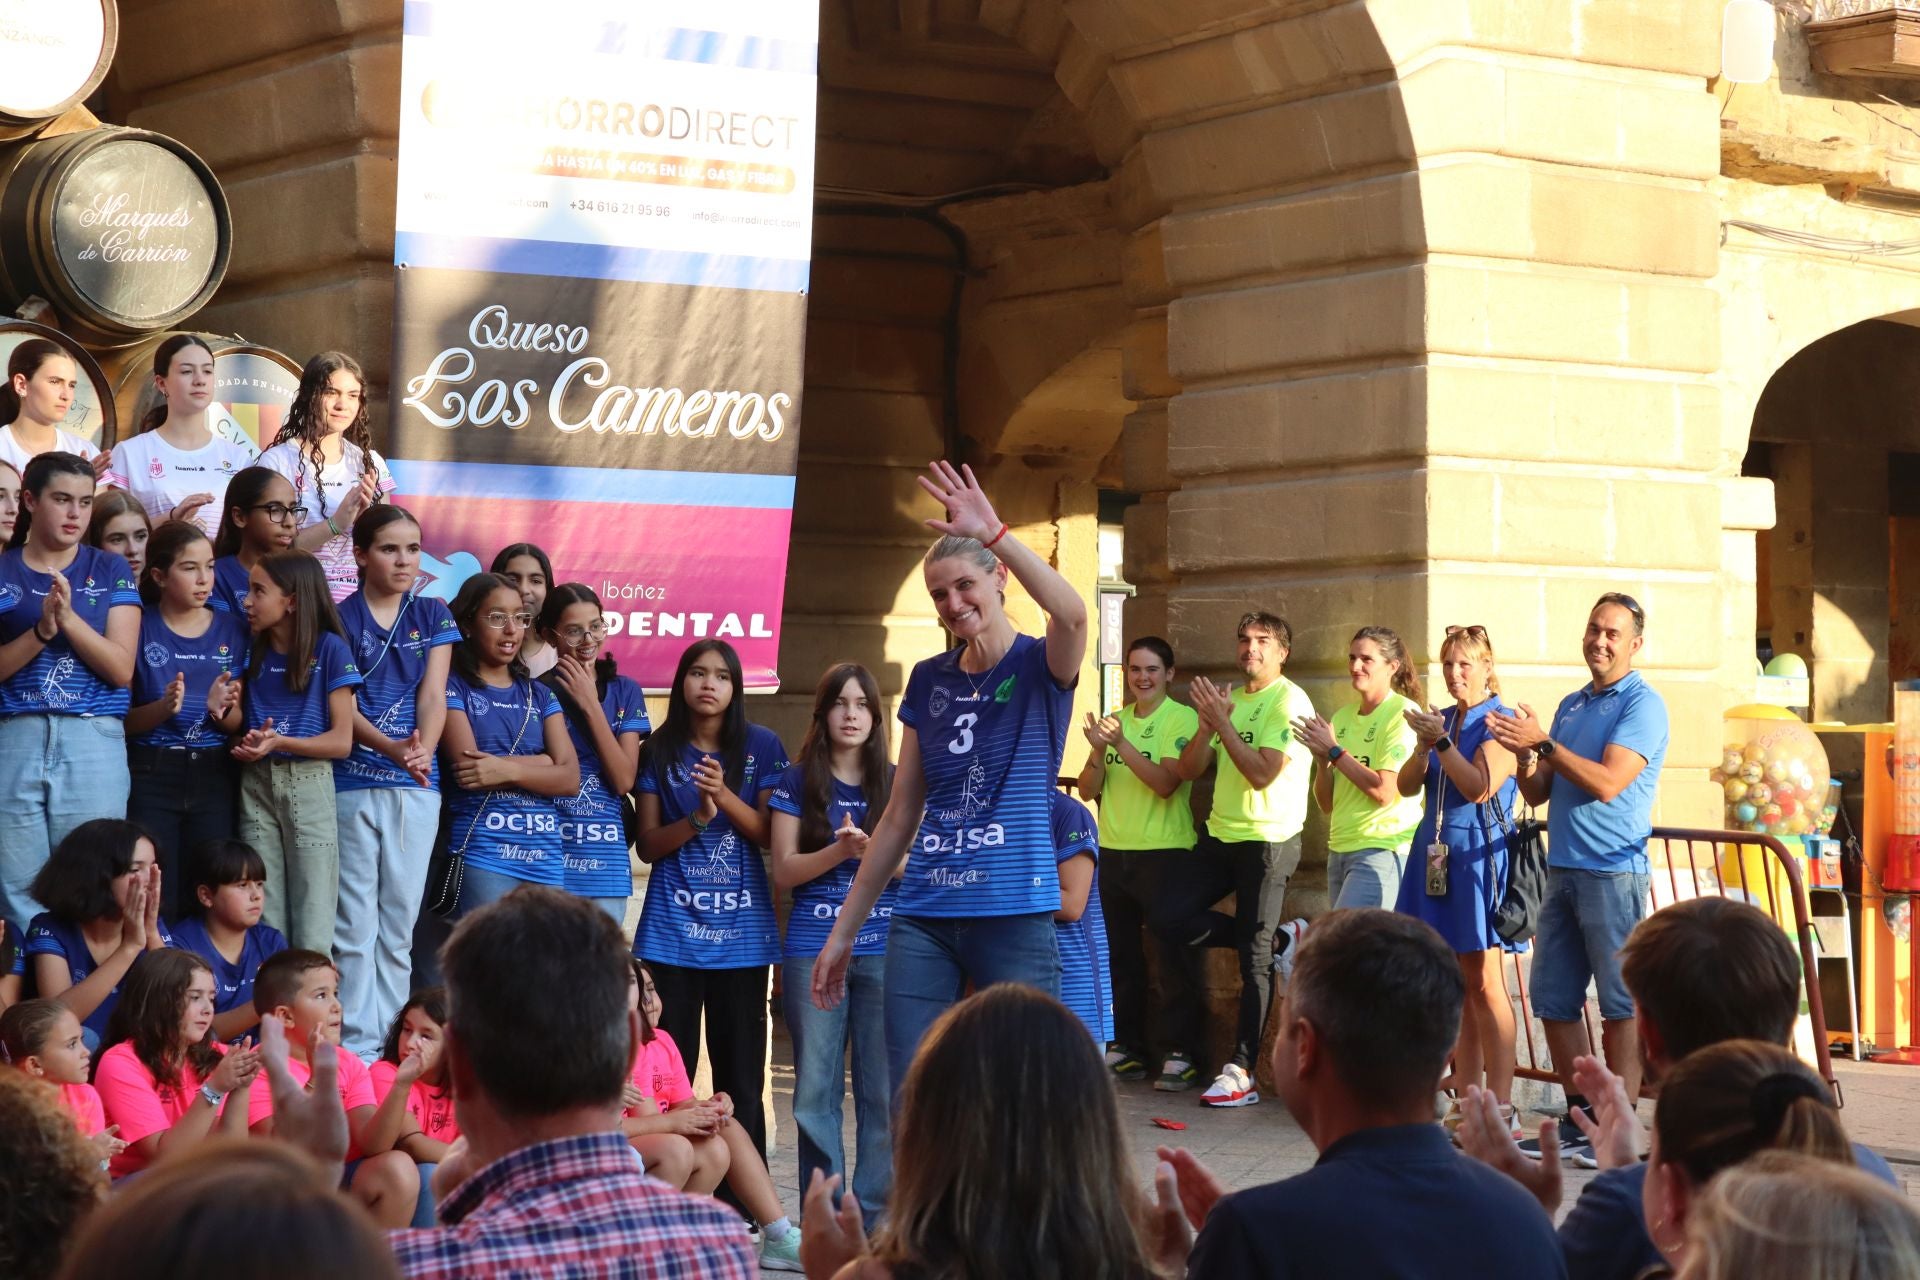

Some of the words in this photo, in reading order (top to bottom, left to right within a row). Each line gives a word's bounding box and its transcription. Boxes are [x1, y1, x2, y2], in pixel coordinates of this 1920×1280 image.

[556, 155, 605, 170] HASTA
[659, 163, 676, 177] EN
[707, 168, 735, 182] GAS
[79, 192, 194, 240] Marqués
[569, 200, 594, 211] +34
[597, 202, 618, 213] 616
[622, 203, 635, 214] 21
[638, 204, 653, 216] 95
[656, 206, 671, 217] 96
[78, 243, 98, 260] de
[99, 229, 192, 262] Carrión
[468, 304, 590, 354] Queso
[214, 377, 248, 389] DADA
[252, 379, 268, 389] EN
[402, 347, 539, 430] Los
[548, 357, 792, 443] Cameros
[602, 579, 666, 600] Ibáñez
[602, 610, 773, 639] DENTAL
[948, 712, 978, 755] 3
[347, 760, 398, 782] Muga
[499, 843, 545, 863] Muga
[713, 876, 731, 885] RIOJA
[928, 867, 980, 888] Muga
[686, 922, 743, 943] Muga
